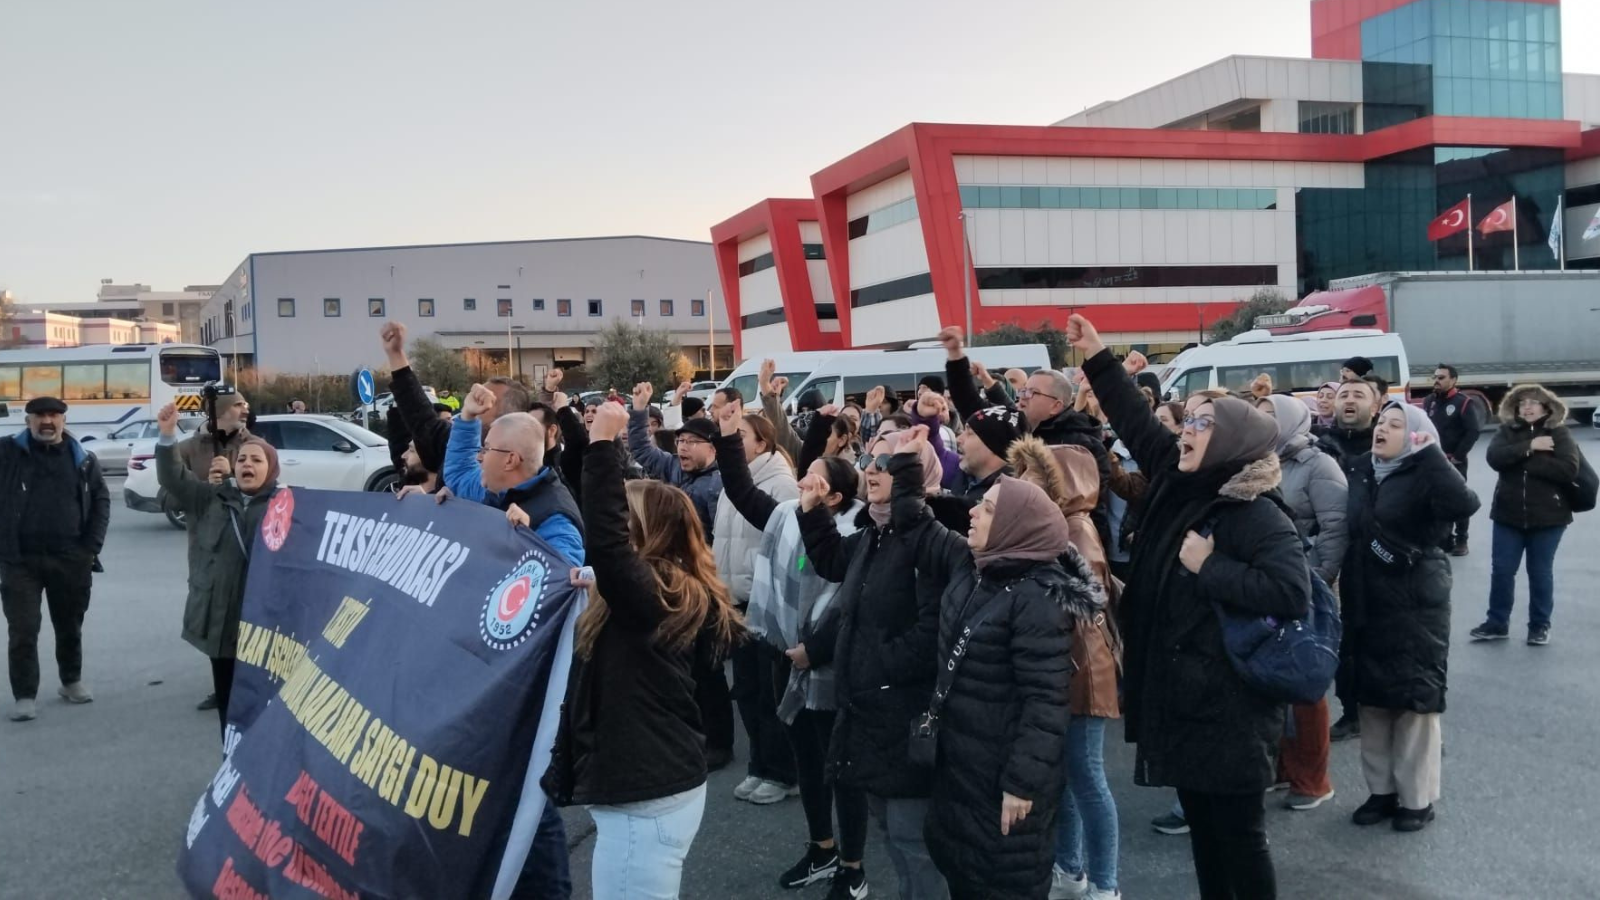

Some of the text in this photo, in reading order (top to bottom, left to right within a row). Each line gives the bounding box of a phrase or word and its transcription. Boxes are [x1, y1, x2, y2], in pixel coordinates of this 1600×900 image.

[1371, 539, 1394, 562] DIGEL
[490, 618, 511, 635] 1952
[350, 718, 417, 806] SAYGI
[404, 754, 490, 837] DUY
